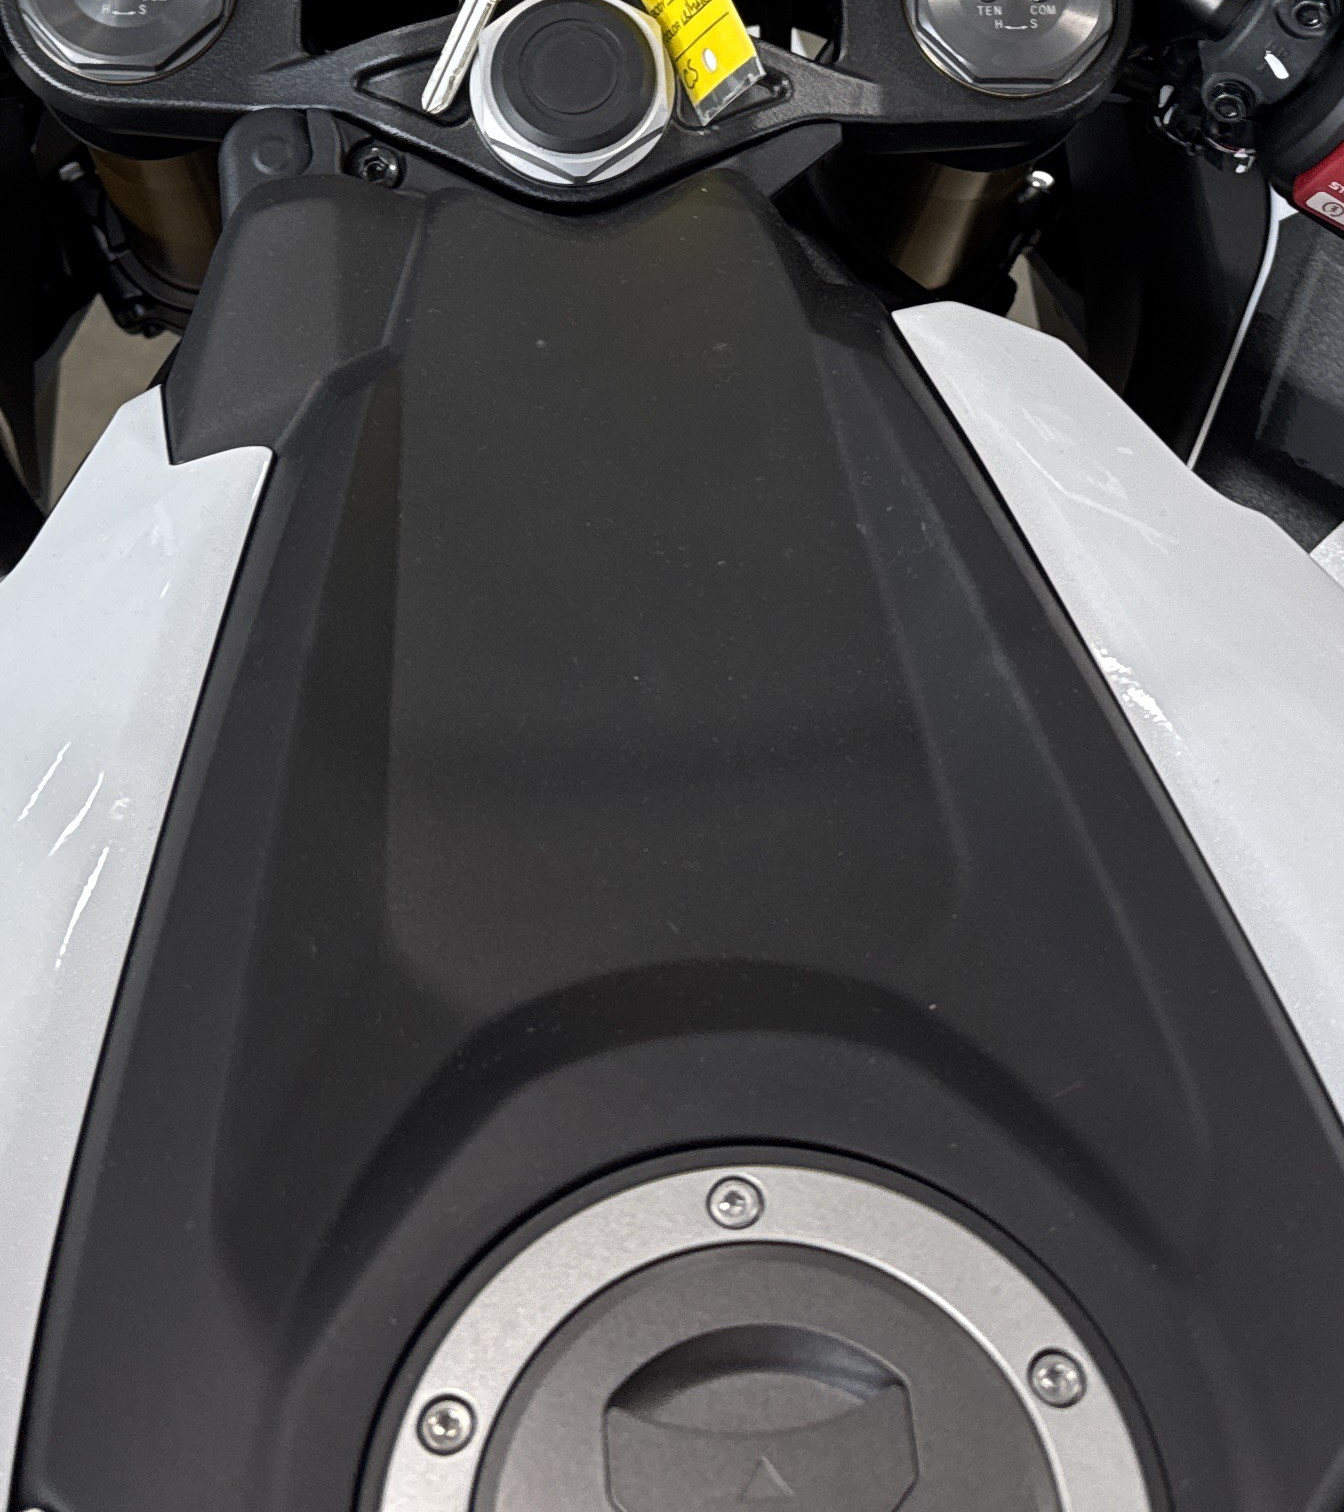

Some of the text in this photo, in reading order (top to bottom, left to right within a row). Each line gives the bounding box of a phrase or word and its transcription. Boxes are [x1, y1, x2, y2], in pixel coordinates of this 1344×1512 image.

[138, 4, 147, 15] S
[977, 4, 1056, 16] TEN COM
[994, 18, 1039, 29] H S
